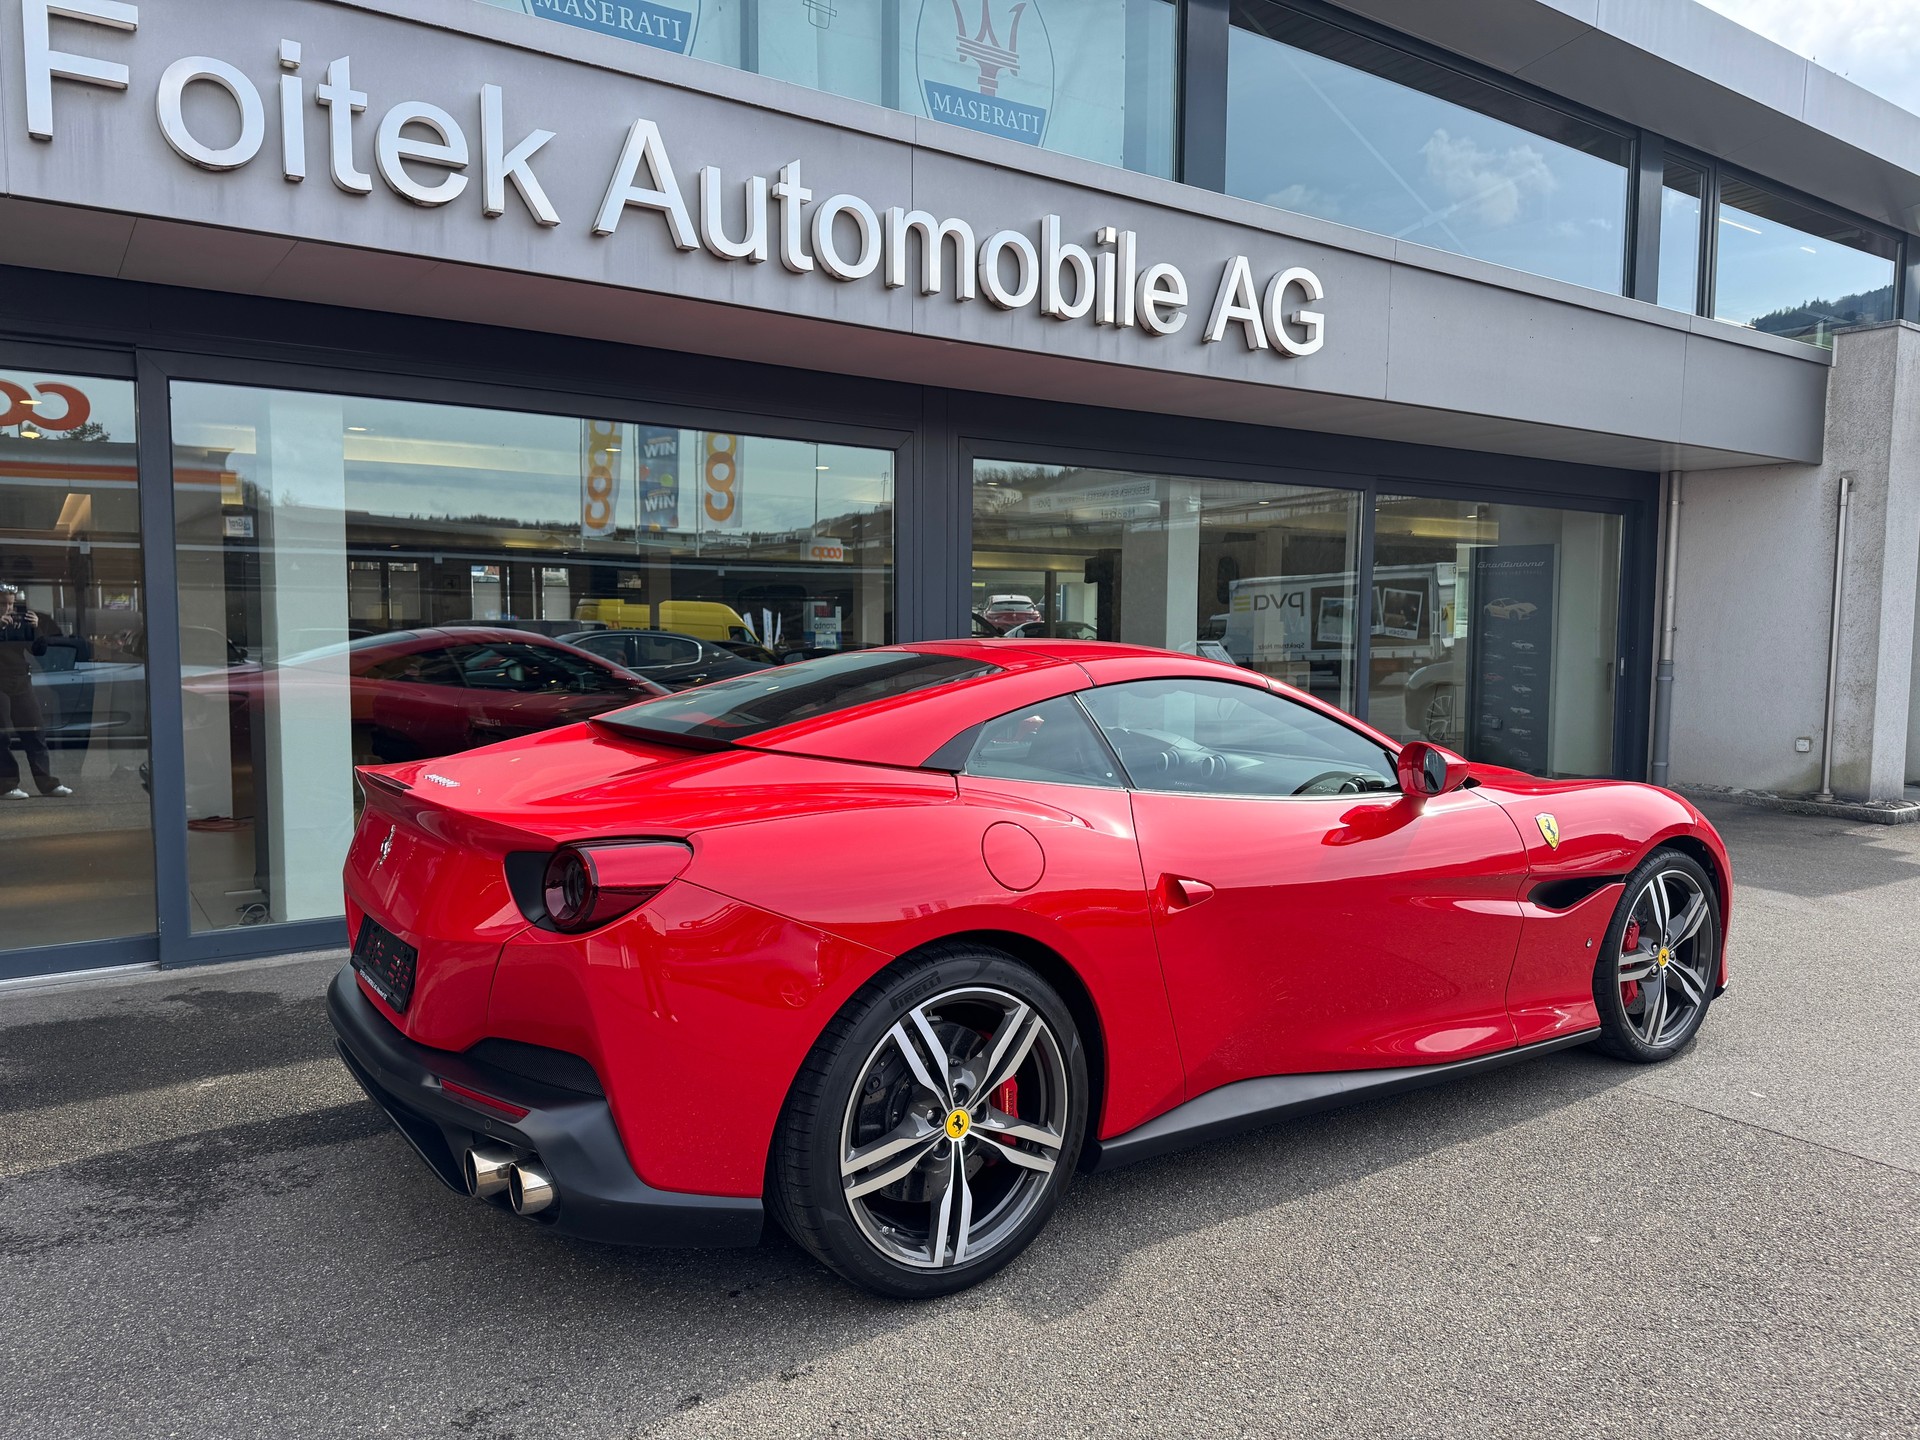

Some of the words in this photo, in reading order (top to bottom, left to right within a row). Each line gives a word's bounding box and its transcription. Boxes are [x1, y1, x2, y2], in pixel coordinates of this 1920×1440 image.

[933, 91, 1040, 135] MASERATI
[22, 0, 562, 227] Foitek
[592, 118, 1189, 337] Automobile
[1202, 255, 1325, 357] AG
[643, 440, 676, 459] WIN
[644, 495, 675, 513] WIN
[1477, 560, 1545, 569] GranTurismo
[889, 971, 941, 1012] PIRELLI
